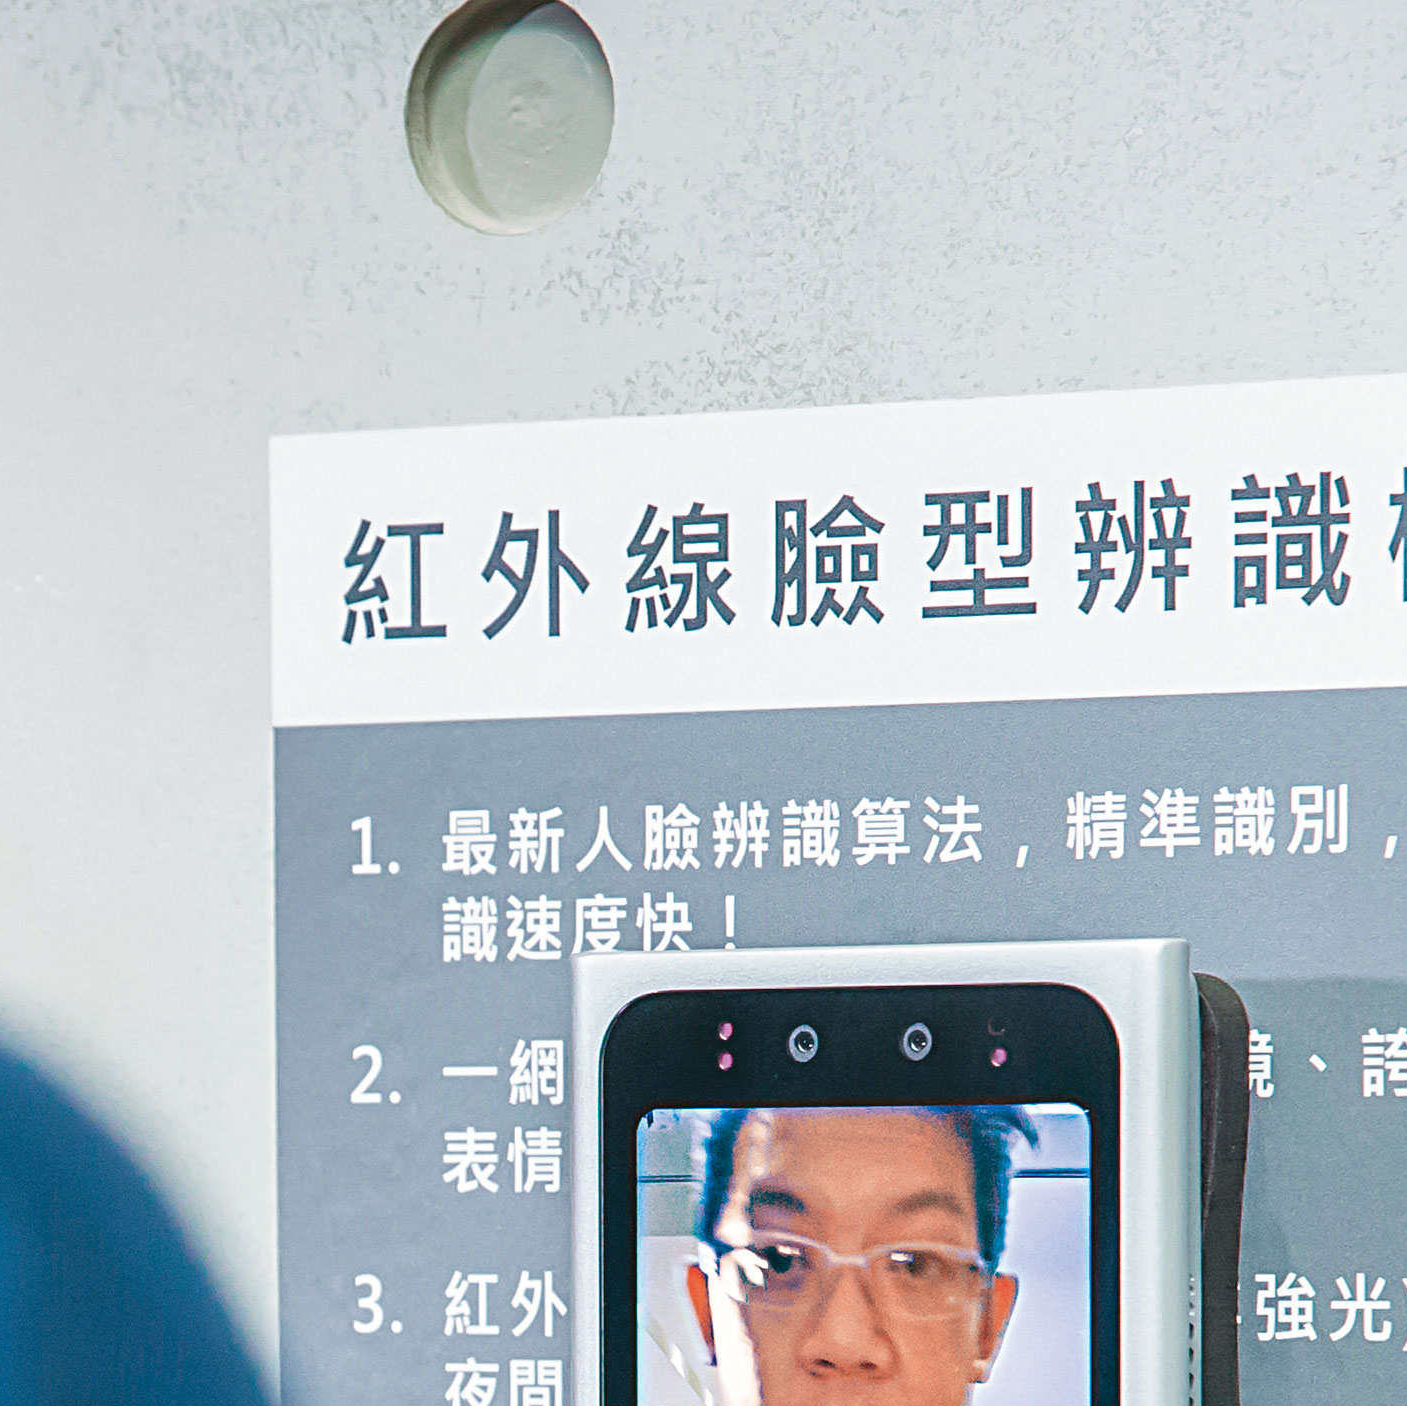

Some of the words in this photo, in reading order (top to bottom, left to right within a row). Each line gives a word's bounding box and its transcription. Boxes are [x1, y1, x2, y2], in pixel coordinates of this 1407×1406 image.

[350, 816, 400, 875] 1.
[350, 1044, 401, 1104] 2.
[443, 1039, 564, 1105] 一網
[442, 1126, 563, 1194] 表情
[352, 1273, 403, 1334] 3.
[444, 1270, 568, 1337] 紅外
